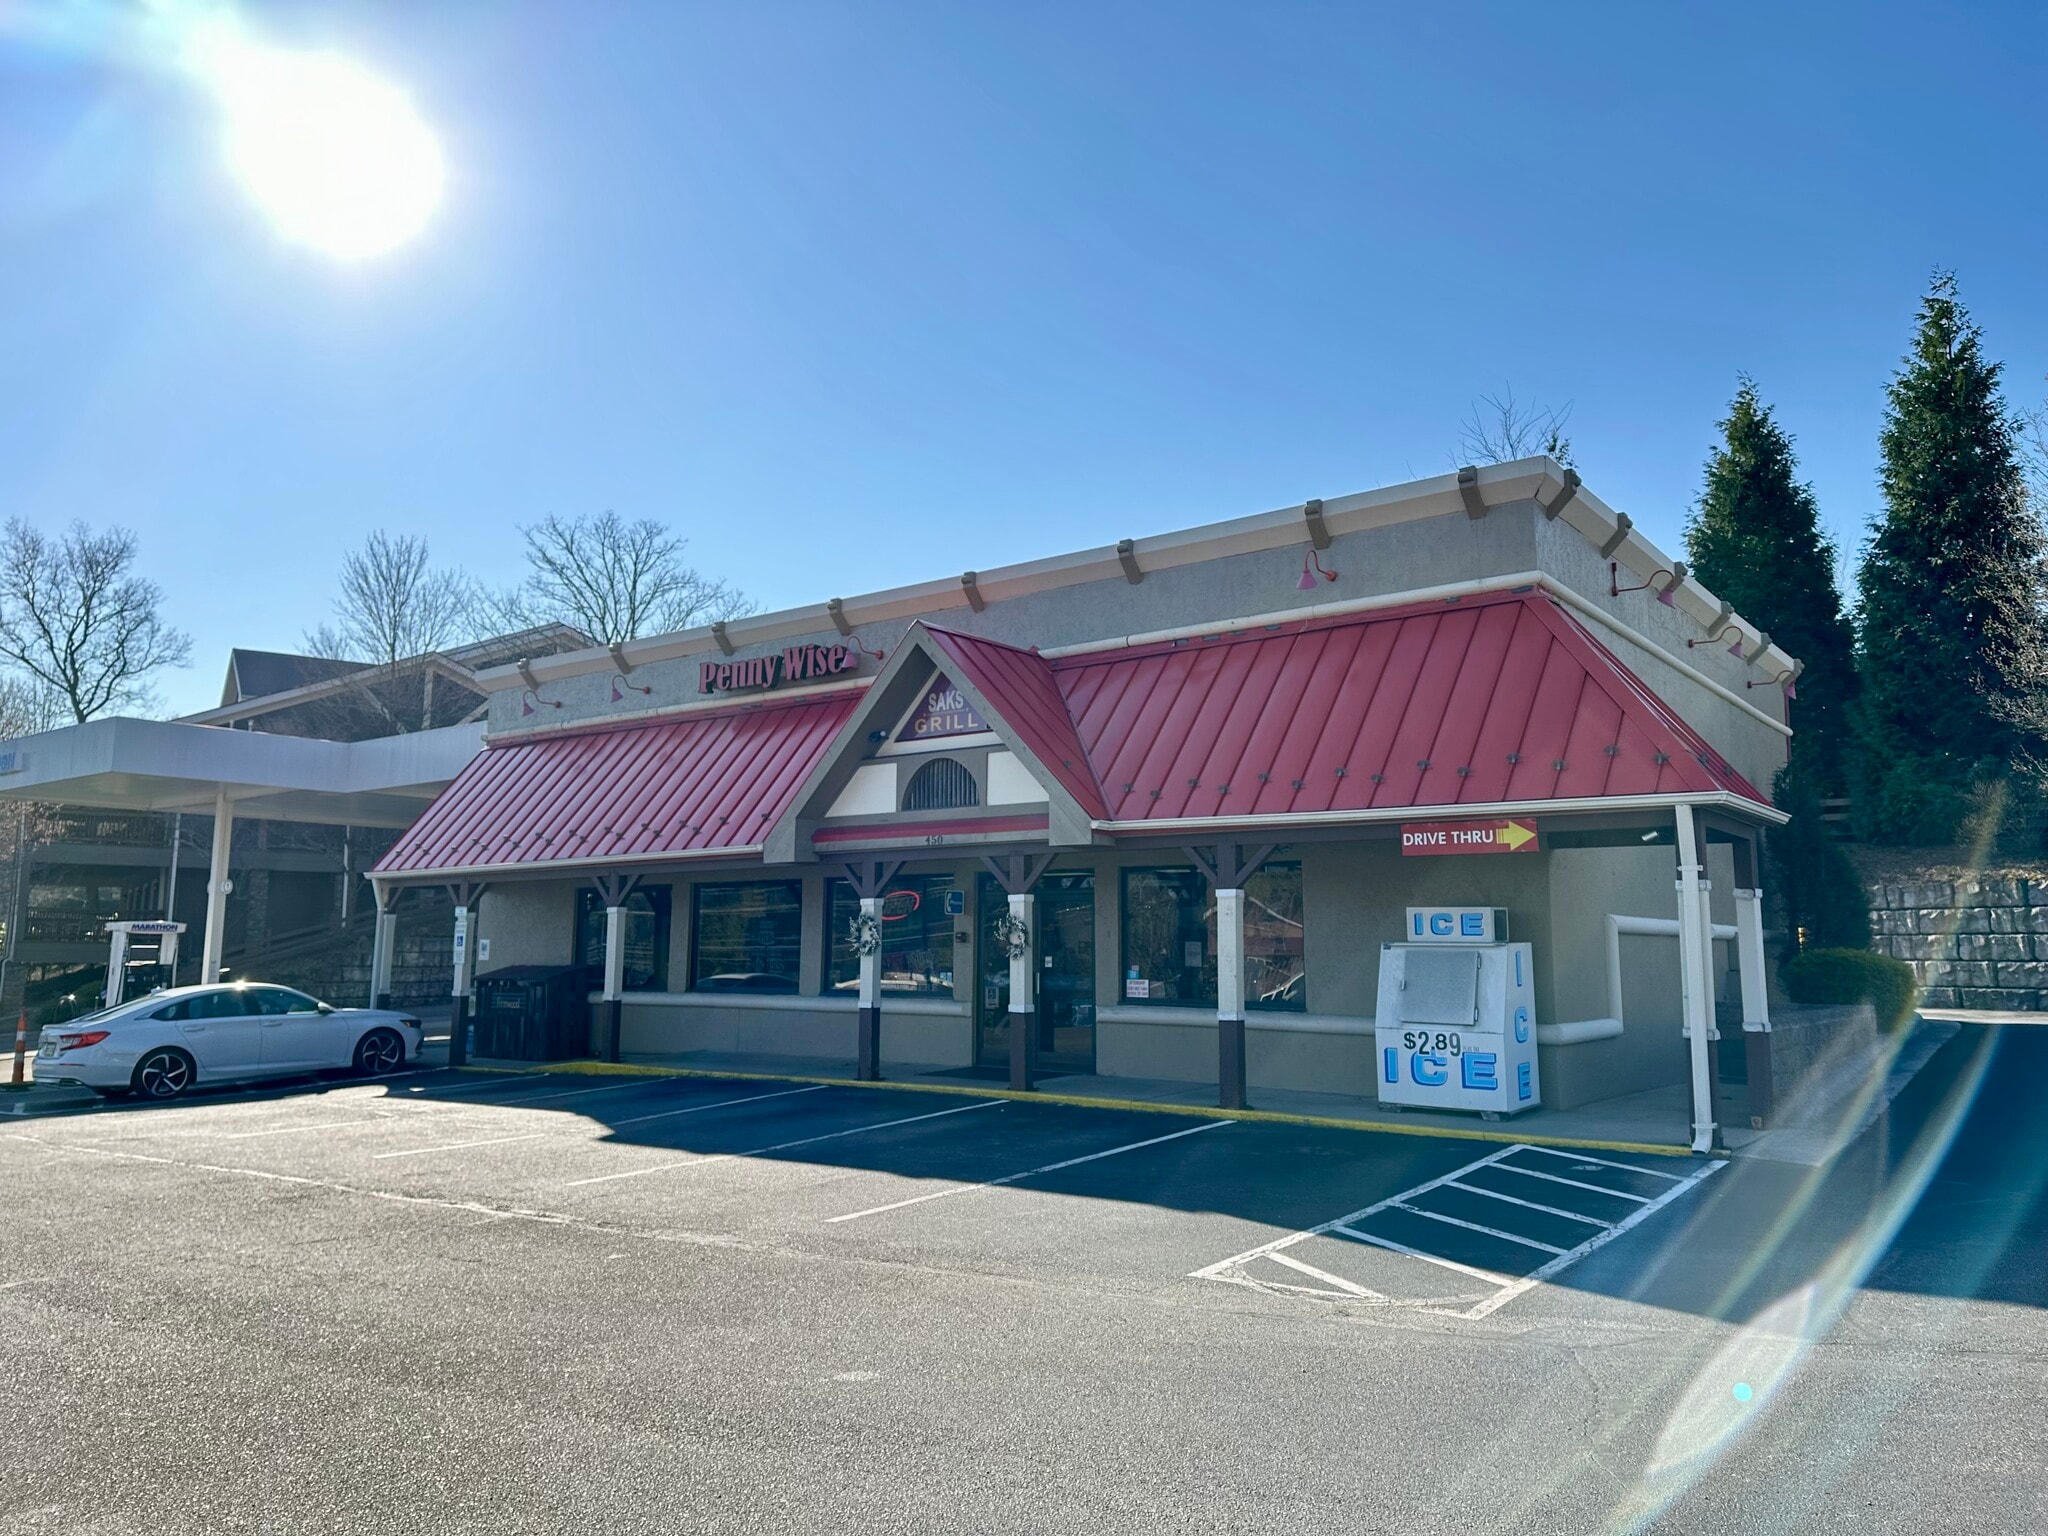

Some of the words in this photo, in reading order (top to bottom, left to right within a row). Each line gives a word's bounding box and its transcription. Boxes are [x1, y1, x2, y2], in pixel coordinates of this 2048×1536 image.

[698, 655, 779, 694] Penny
[782, 643, 845, 681] Wise
[928, 690, 964, 713] SAKS
[914, 713, 978, 733] GRILL
[925, 834, 944, 846] 450
[1402, 831, 1447, 846] DRIVE
[1450, 829, 1494, 845] THRU
[131, 923, 179, 933] MARATHON
[1414, 912, 1485, 936] ICE
[1514, 951, 1532, 1101] ICE
[1403, 1031, 1462, 1057] $2.89
[1384, 1047, 1498, 1091] ICE
